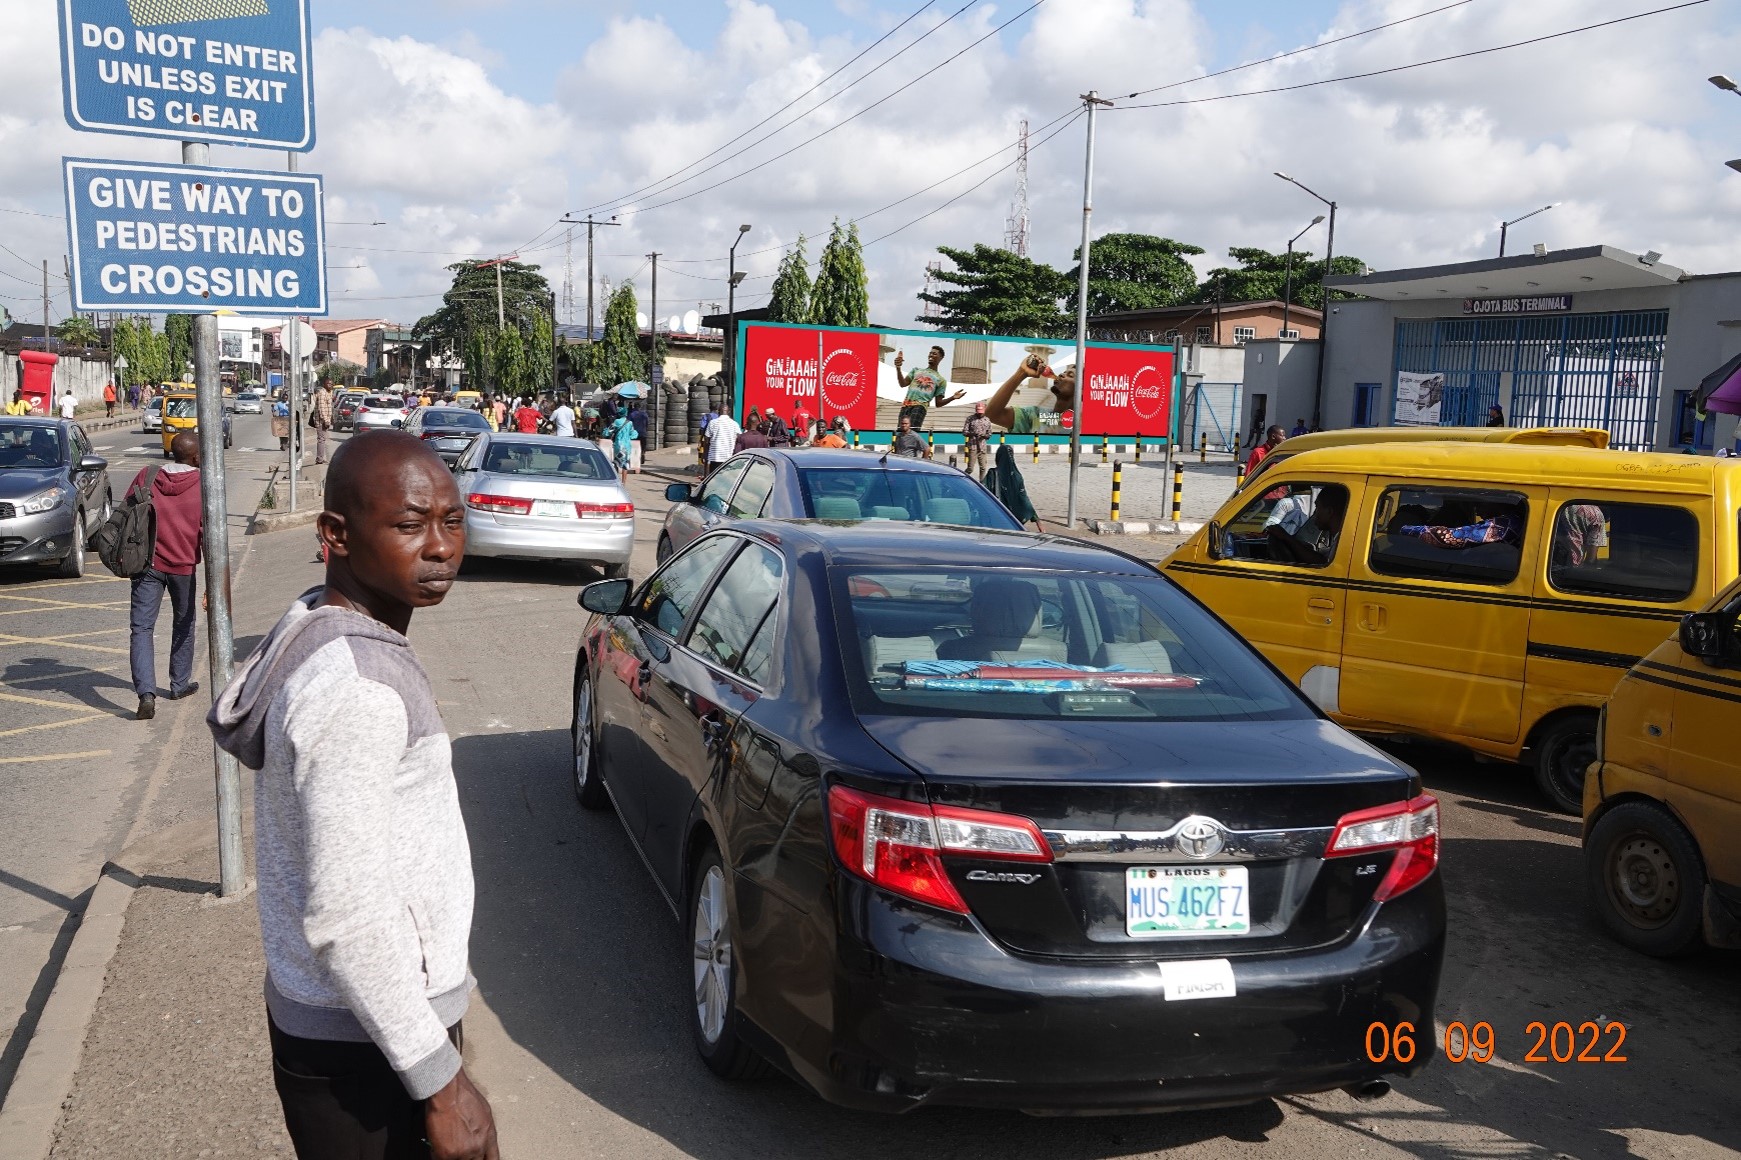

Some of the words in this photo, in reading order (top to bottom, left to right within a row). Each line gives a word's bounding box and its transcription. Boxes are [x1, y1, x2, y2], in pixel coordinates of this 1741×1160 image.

[82, 23, 124, 50] DO
[135, 30, 196, 60] NOT
[206, 40, 297, 74] ENTER
[99, 59, 216, 95] UNLESS
[225, 75, 287, 103] EXIT
[127, 96, 155, 120] IS
[165, 101, 258, 131] CLEAR
[89, 177, 172, 210] GIVE
[181, 183, 252, 215] WAY
[262, 188, 303, 218] TO
[96, 220, 304, 257] PEDESTRIANS
[101, 264, 299, 298] CROSSING
[1473, 300, 1500, 313] OJOTA
[1501, 298, 1520, 312] BUS
[1521, 296, 1567, 311] TERMINAL
[765, 377, 784, 388] YOUR
[786, 378, 817, 396] FLOW
[1090, 390, 1104, 401] YOUR
[1105, 391, 1129, 407] FLOW
[1165, 868, 1211, 876] LAGOS
